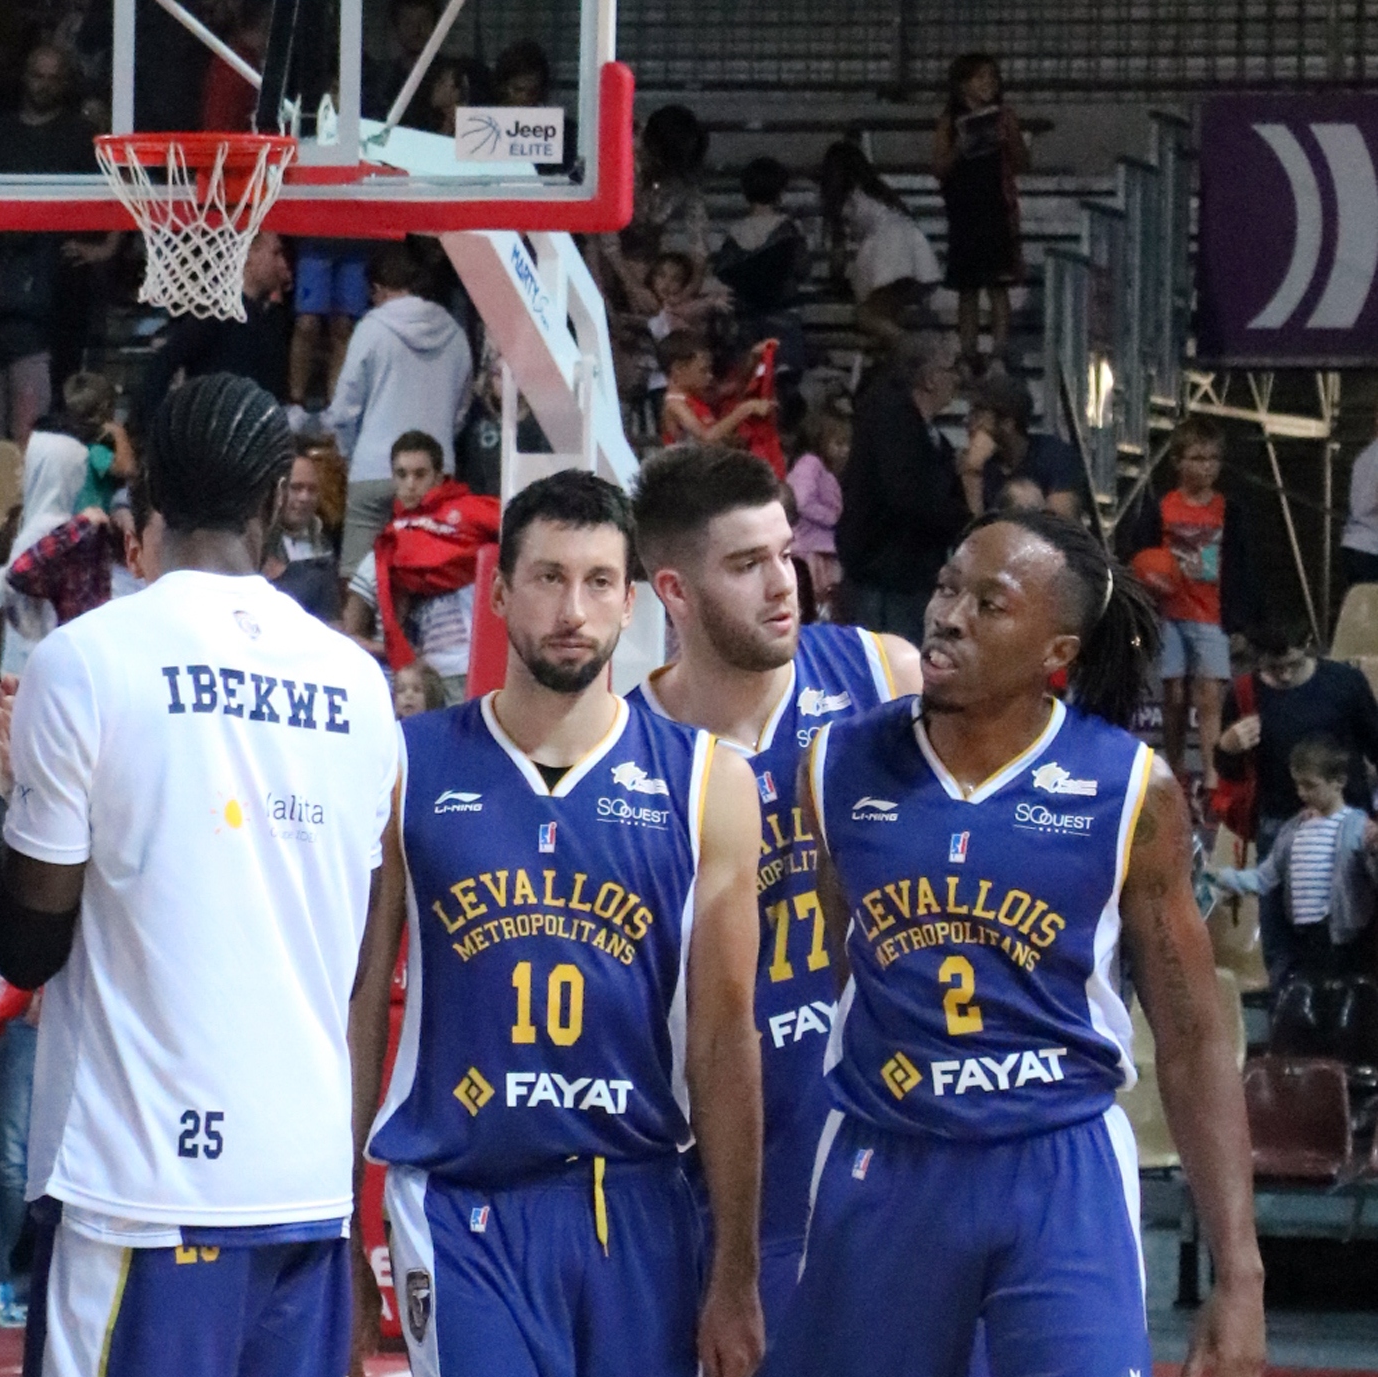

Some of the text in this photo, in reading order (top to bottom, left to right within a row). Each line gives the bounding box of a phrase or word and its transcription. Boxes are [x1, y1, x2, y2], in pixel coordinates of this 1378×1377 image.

[506, 121, 556, 141] Jeep
[509, 143, 553, 156] ELITE
[161, 664, 351, 735] IBEKWE
[434, 804, 482, 814] LI-NING
[852, 812, 898, 821] LI-NING
[432, 868, 653, 940] LEVALLOIS
[856, 876, 1066, 947] LEVALLOIS
[452, 914, 636, 965] METROPOLITANS
[766, 891, 830, 983] 77
[875, 921, 1042, 972] METROPOLITANS
[512, 962, 584, 1046] 10
[939, 955, 983, 1036] 2
[506, 1073, 634, 1114] FAYAT
[930, 1048, 1067, 1096] FAYAT
[178, 1109, 224, 1160] 25
